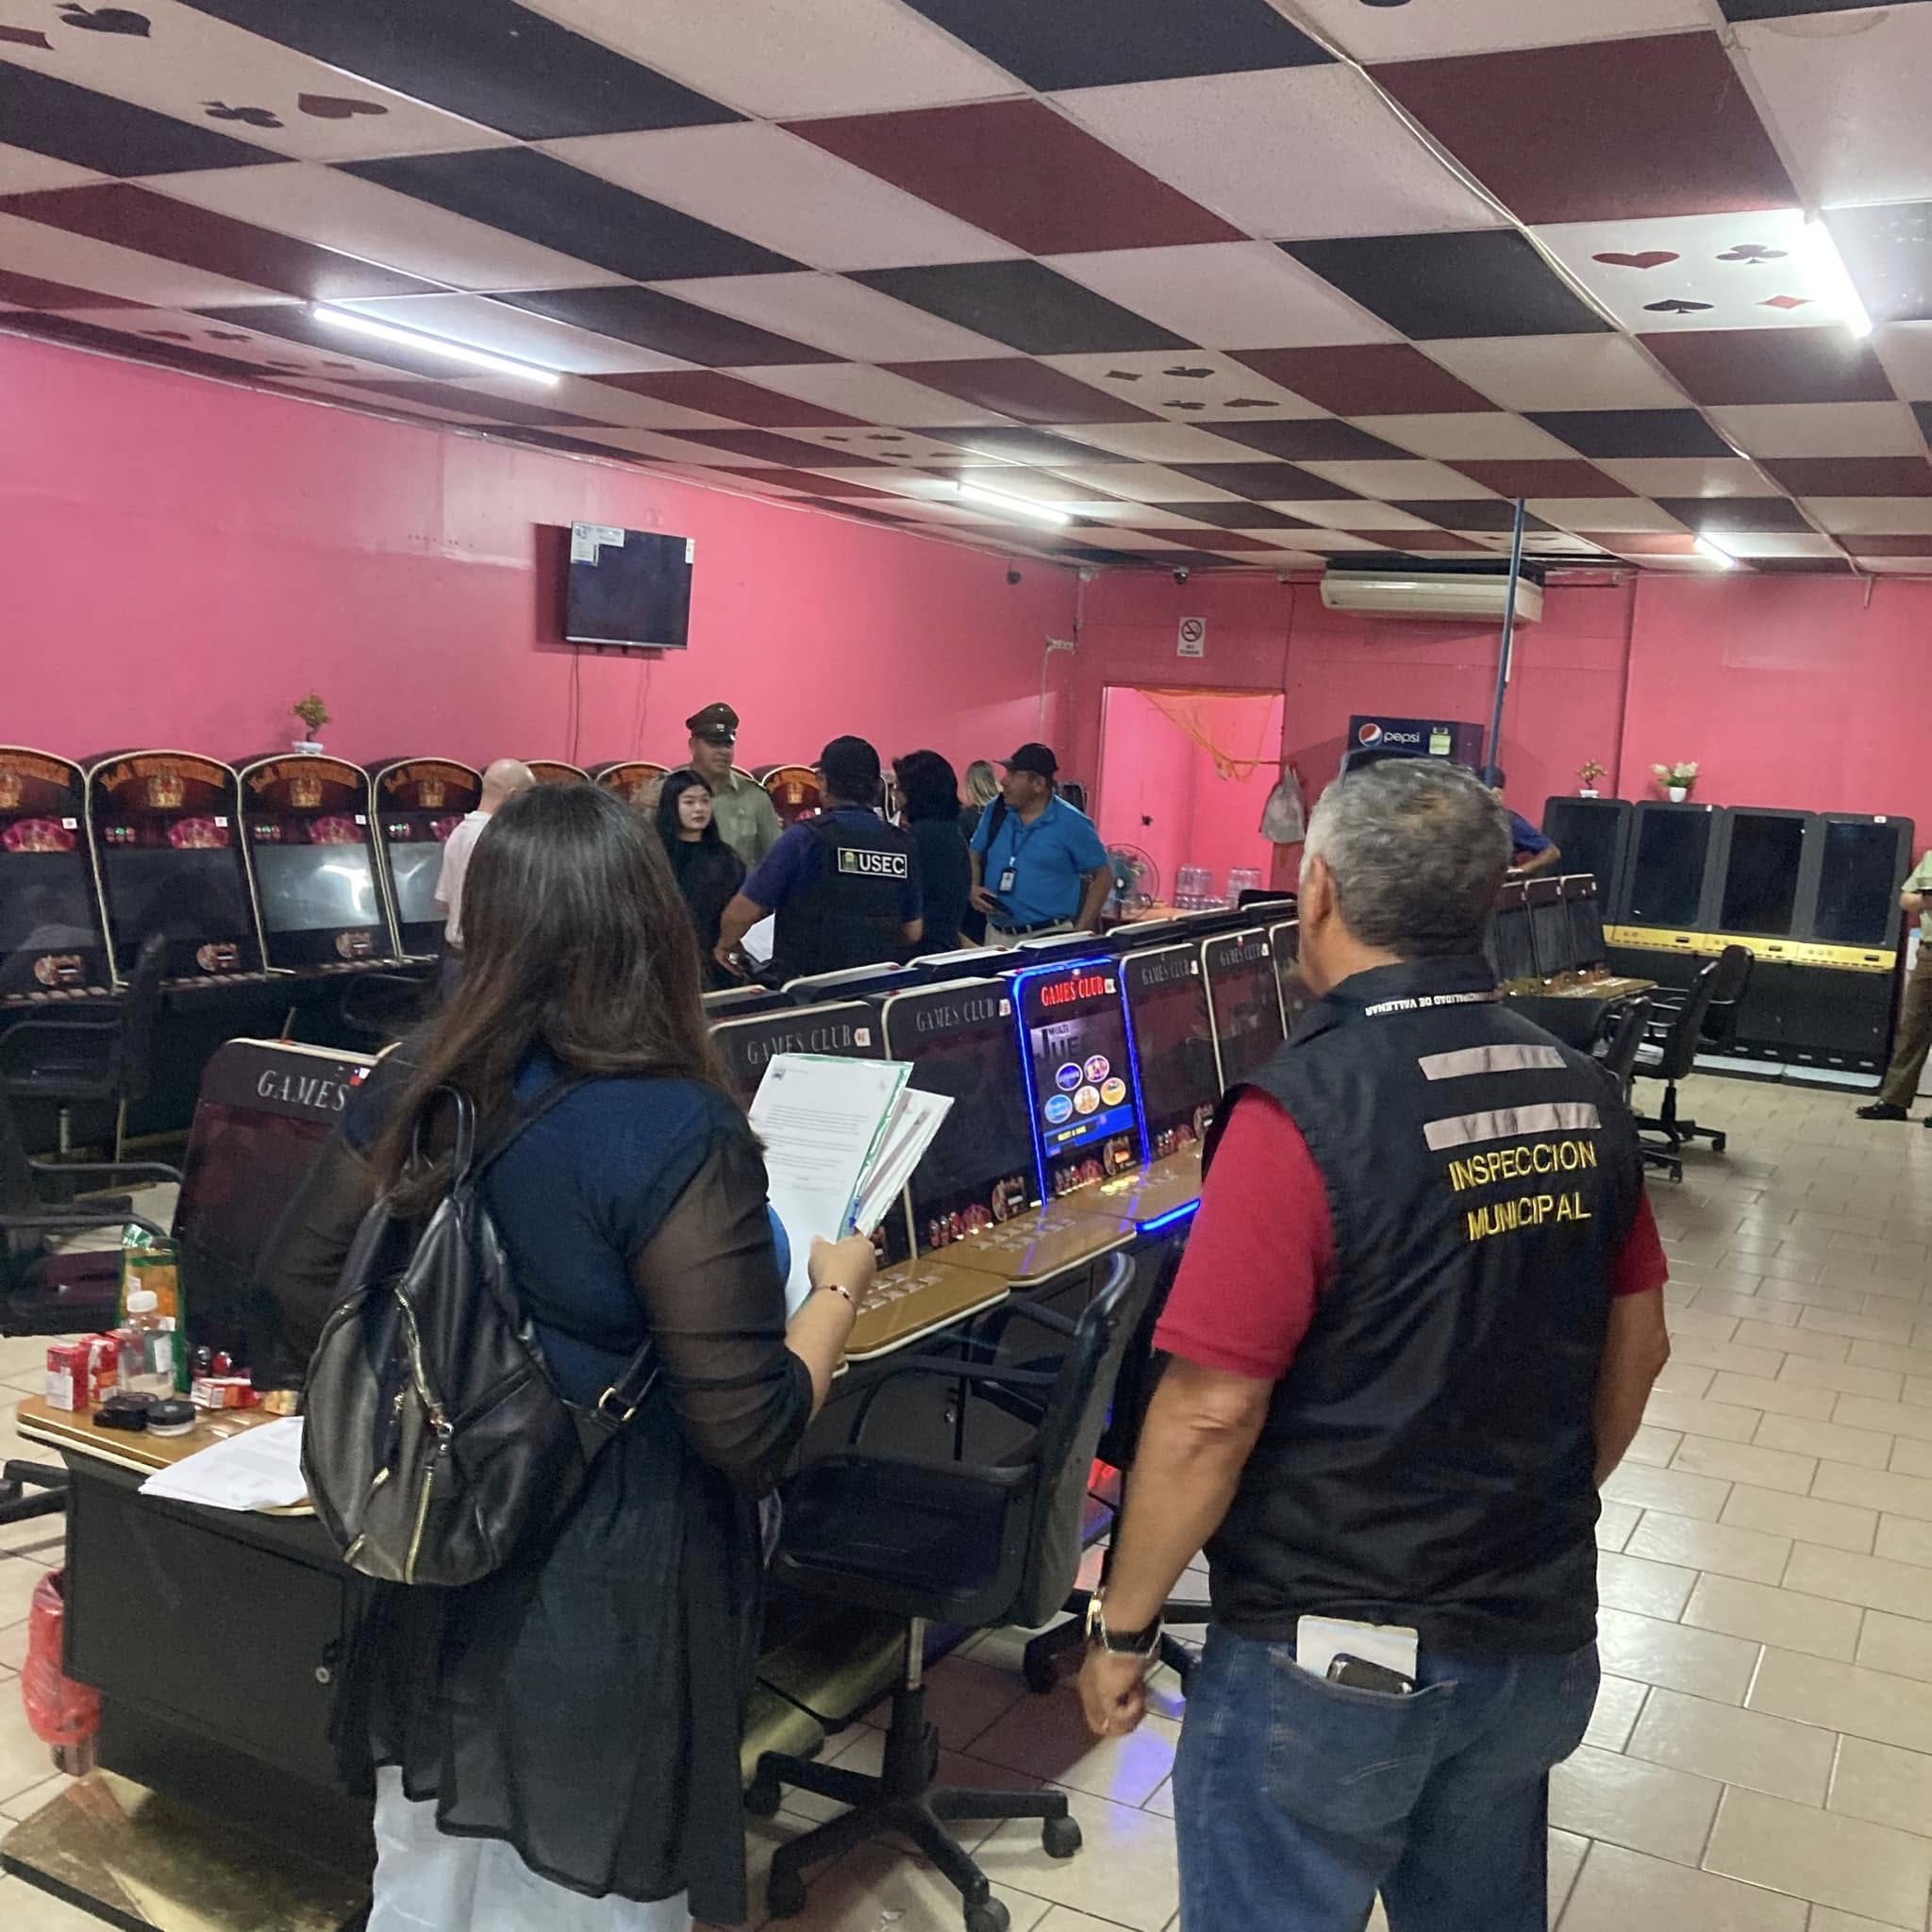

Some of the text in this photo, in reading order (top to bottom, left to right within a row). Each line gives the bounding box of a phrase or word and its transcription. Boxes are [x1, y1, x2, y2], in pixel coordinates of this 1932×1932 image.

[1384, 732, 1421, 743] pepsi
[858, 853, 905, 874] USEC
[1041, 975, 1104, 1007] GAMES CLUB
[1141, 964, 1168, 986] GAMES
[915, 999, 995, 1033] GAMES CLUB
[1365, 998, 1417, 1016] VALLENAR
[1419, 995, 1433, 1008] DE
[746, 1033, 804, 1065] GAMES
[810, 1024, 852, 1053] CLUB
[257, 1069, 350, 1111] GAMES
[1448, 1140, 1597, 1191] INSPECCION
[1467, 1191, 1592, 1241] MUNICIPAL
